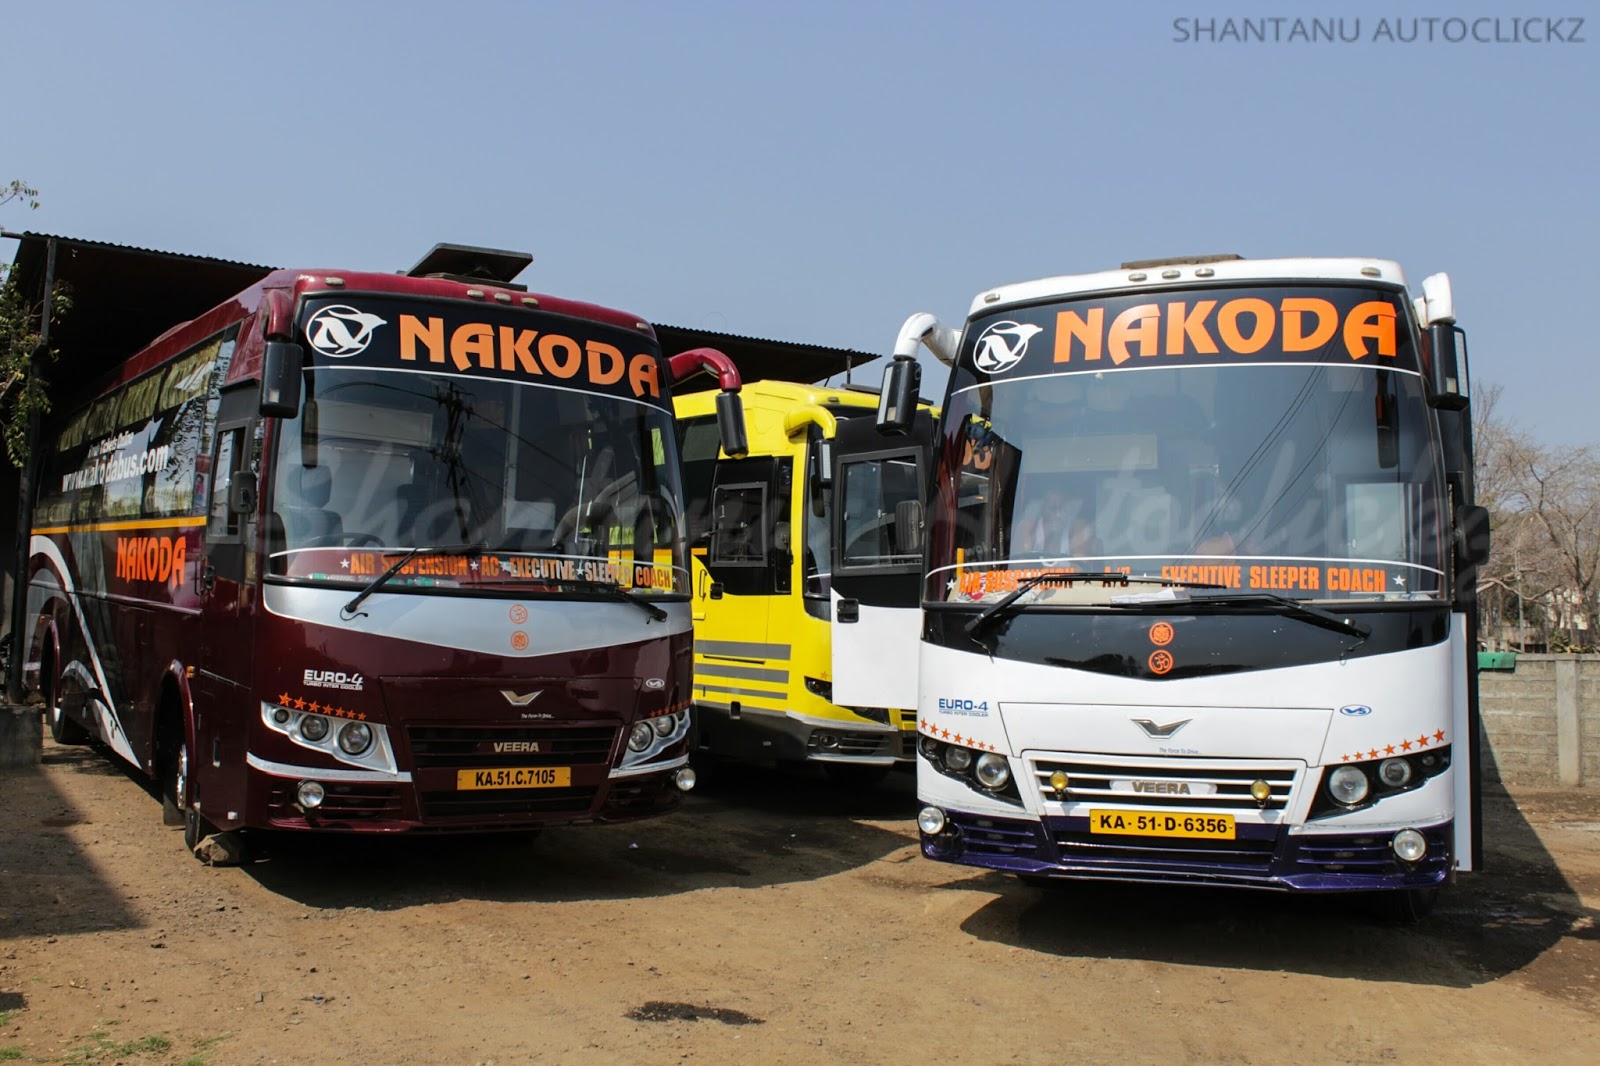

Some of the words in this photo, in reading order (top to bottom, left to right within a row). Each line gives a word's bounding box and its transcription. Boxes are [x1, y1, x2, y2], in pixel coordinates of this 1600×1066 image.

[1053, 298, 1397, 366] NAKODA
[399, 313, 661, 399] NAKODA
[116, 535, 186, 590] NAKODA
[350, 553, 375, 574] AIR
[480, 556, 499, 577] AC
[509, 557, 575, 581] EXECUTIVE
[635, 566, 671, 588] COACH
[958, 572, 980, 593] AIR
[1160, 565, 1242, 588] EXECUTIVE
[1250, 566, 1320, 590] SLEEPER
[1327, 567, 1387, 592] COACH
[304, 669, 363, 686] EURO-4
[938, 698, 988, 711] EURO-4
[493, 742, 539, 753] VEERA
[1131, 781, 1190, 795] VEERA
